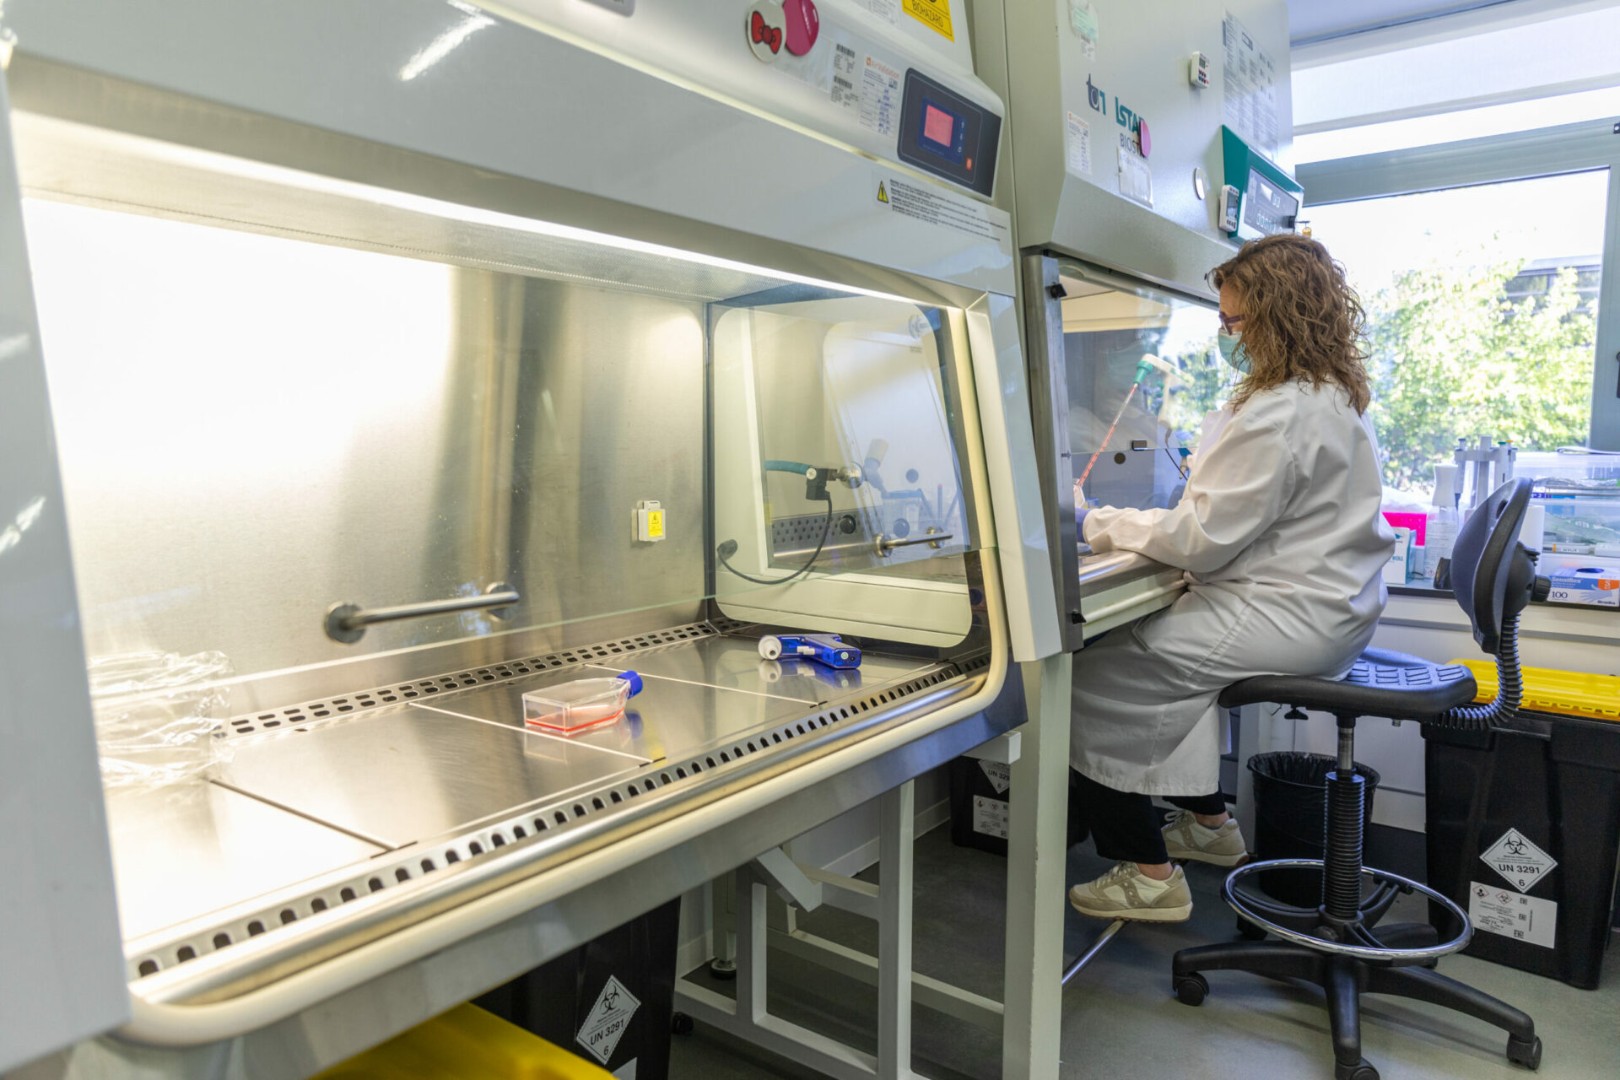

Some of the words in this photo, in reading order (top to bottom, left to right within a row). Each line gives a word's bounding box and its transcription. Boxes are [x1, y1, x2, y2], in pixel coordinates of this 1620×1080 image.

[1517, 866, 1540, 874] 3291
[590, 1032, 603, 1045] UN
[605, 1019, 624, 1036] 3291
[603, 1045, 609, 1056] 6
